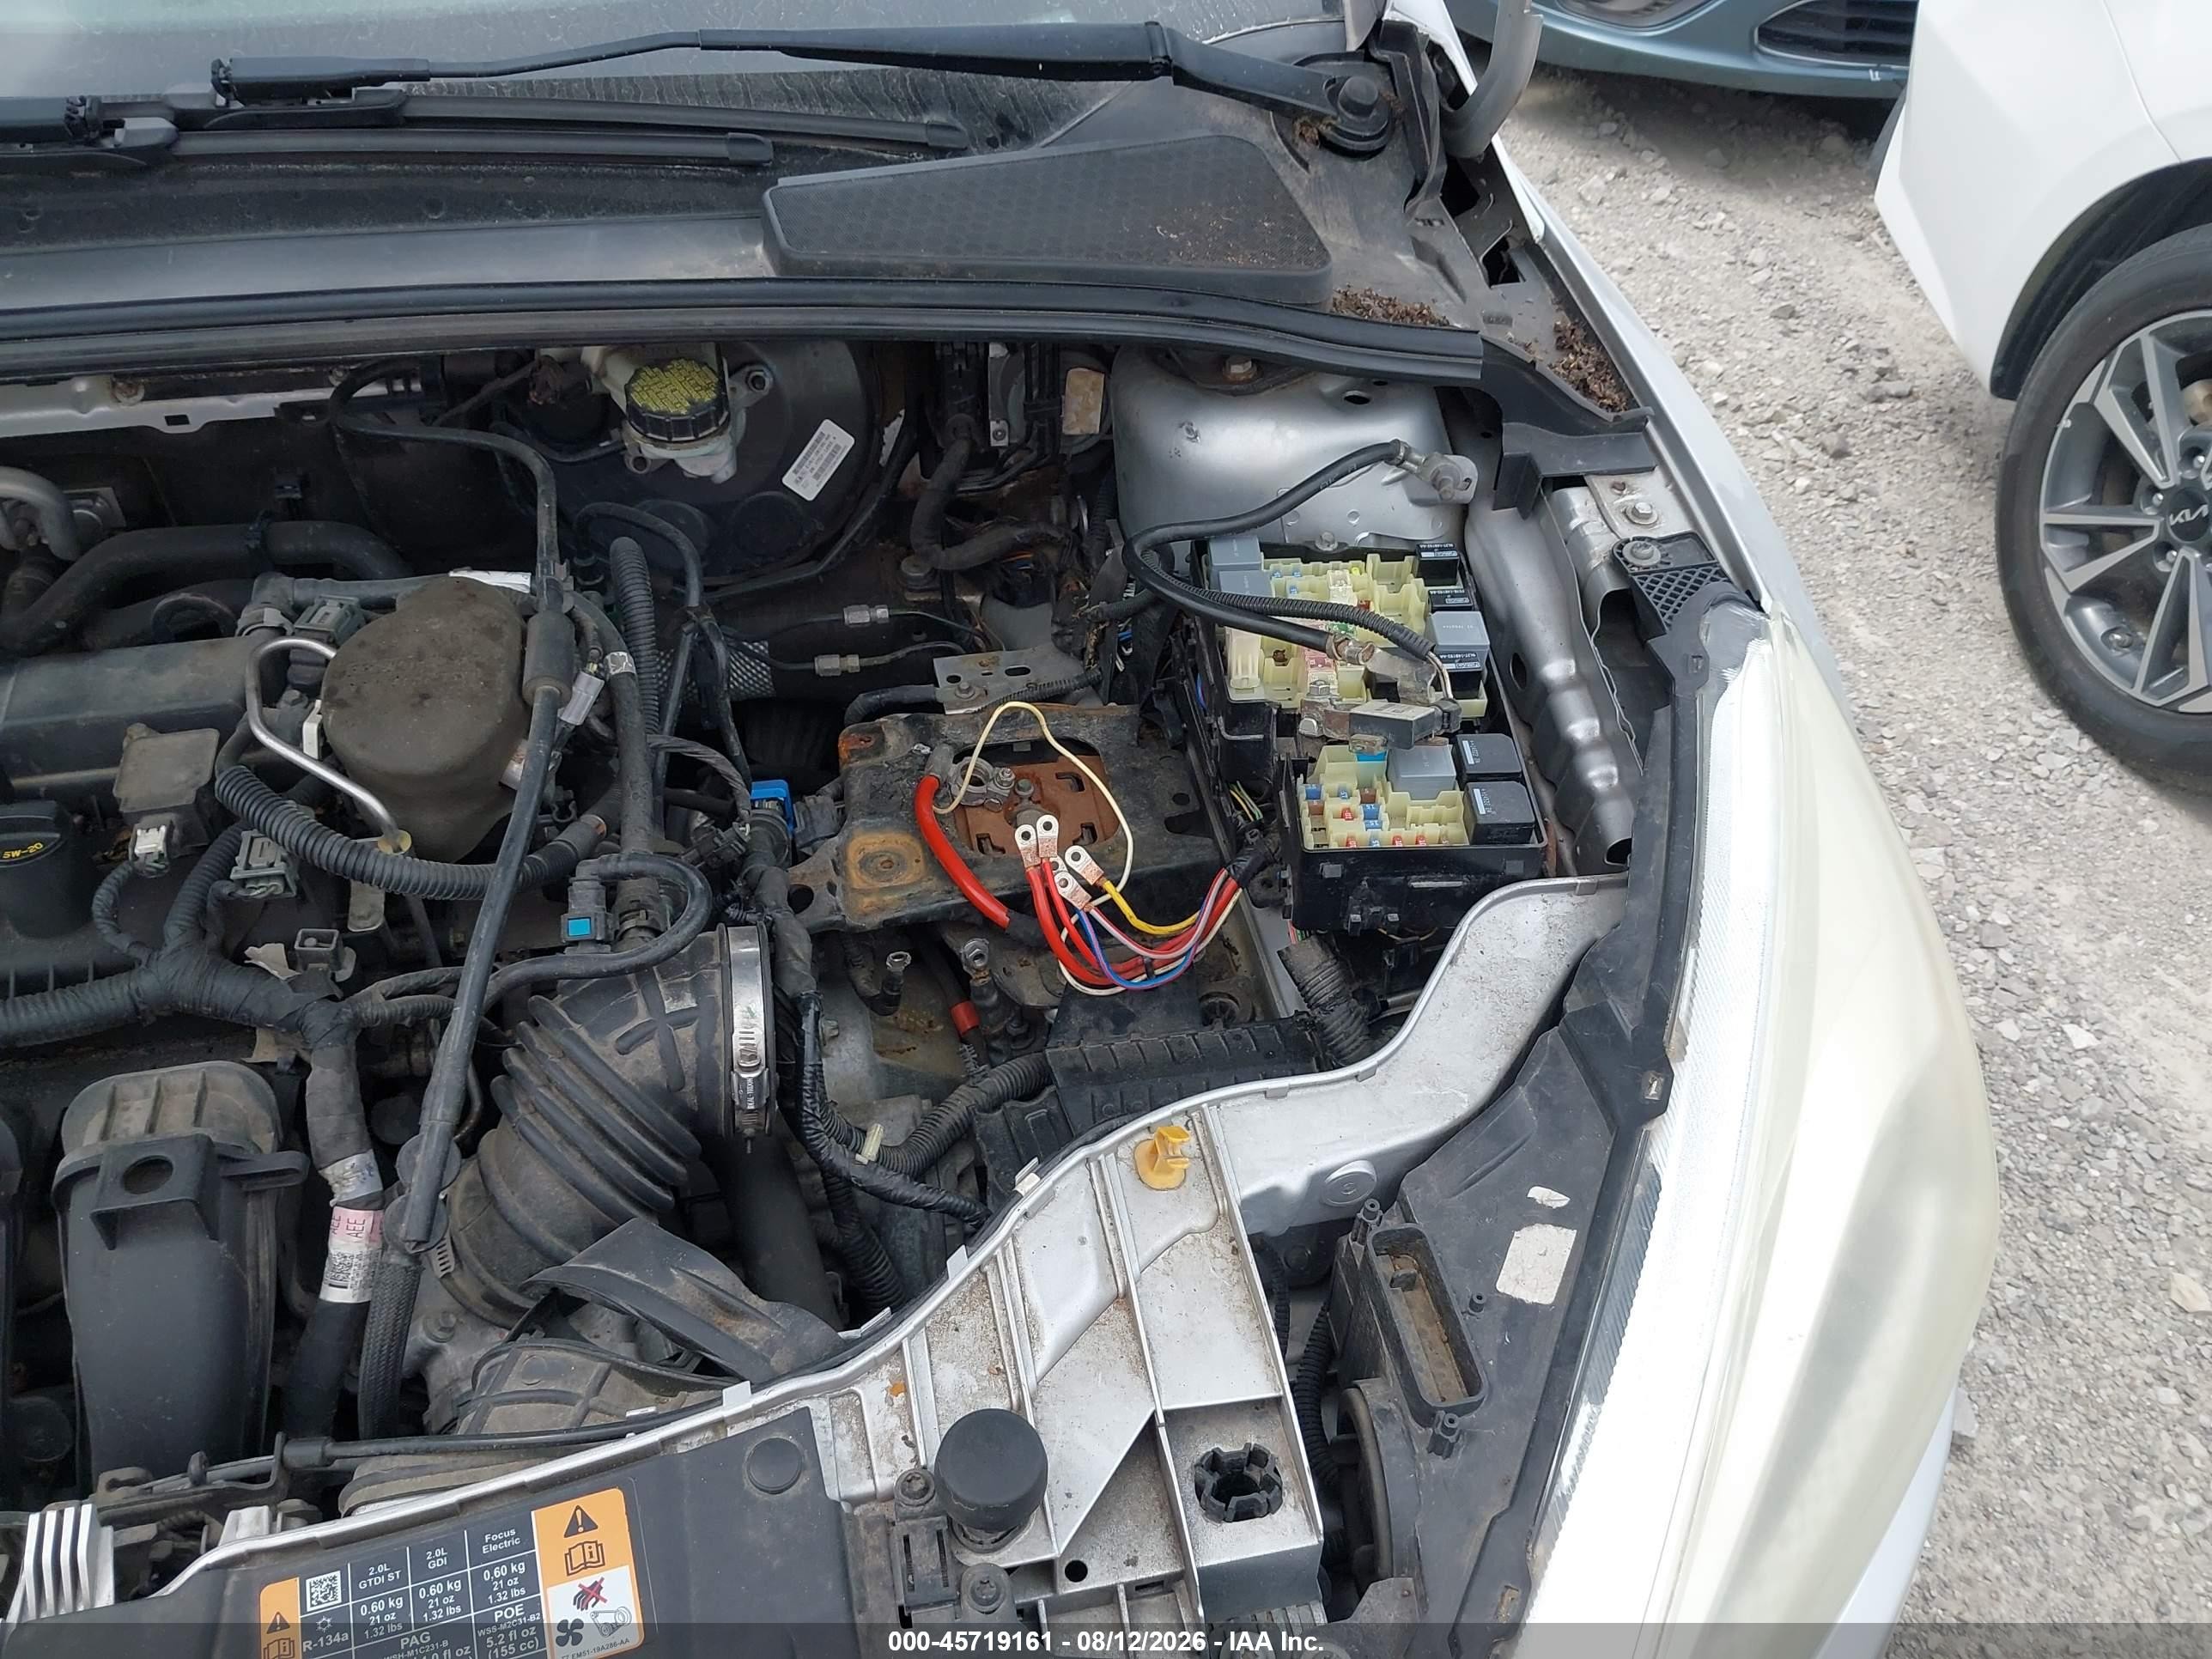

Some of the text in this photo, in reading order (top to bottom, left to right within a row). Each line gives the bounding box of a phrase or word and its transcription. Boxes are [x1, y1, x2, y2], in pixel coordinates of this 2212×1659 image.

[3, 842, 44, 859] 5W-20
[346, 1218, 367, 1238] AEE
[484, 1528, 516, 1543] Focus
[426, 1547, 447, 1560] 2.0L
[482, 1537, 520, 1554] Electric
[368, 1563, 391, 1576] 2.0L
[428, 1557, 447, 1570] GDI
[511, 1562, 526, 1574] kg
[358, 1571, 402, 1589] GTDI ST
[492, 1577, 520, 1591] 21 oz
[419, 1580, 461, 1599] 0.60 kg
[488, 1587, 526, 1604] 1.32 lbs
[361, 1597, 404, 1616] 0.60 kg
[428, 1595, 455, 1609] 21 oz
[369, 1613, 397, 1626] 21 oz
[422, 1605, 462, 1622] 1.32 lbs
[494, 1603, 526, 1623] POE
[364, 1623, 403, 1639] 1.32 lbs
[486, 1626, 537, 1648] 5.2 fl oz
[302, 1631, 349, 1652] R-134a
[400, 1632, 431, 1650] PAG
[489, 1636, 539, 1659] (155 cc)
[455, 1645, 472, 1657] oz
